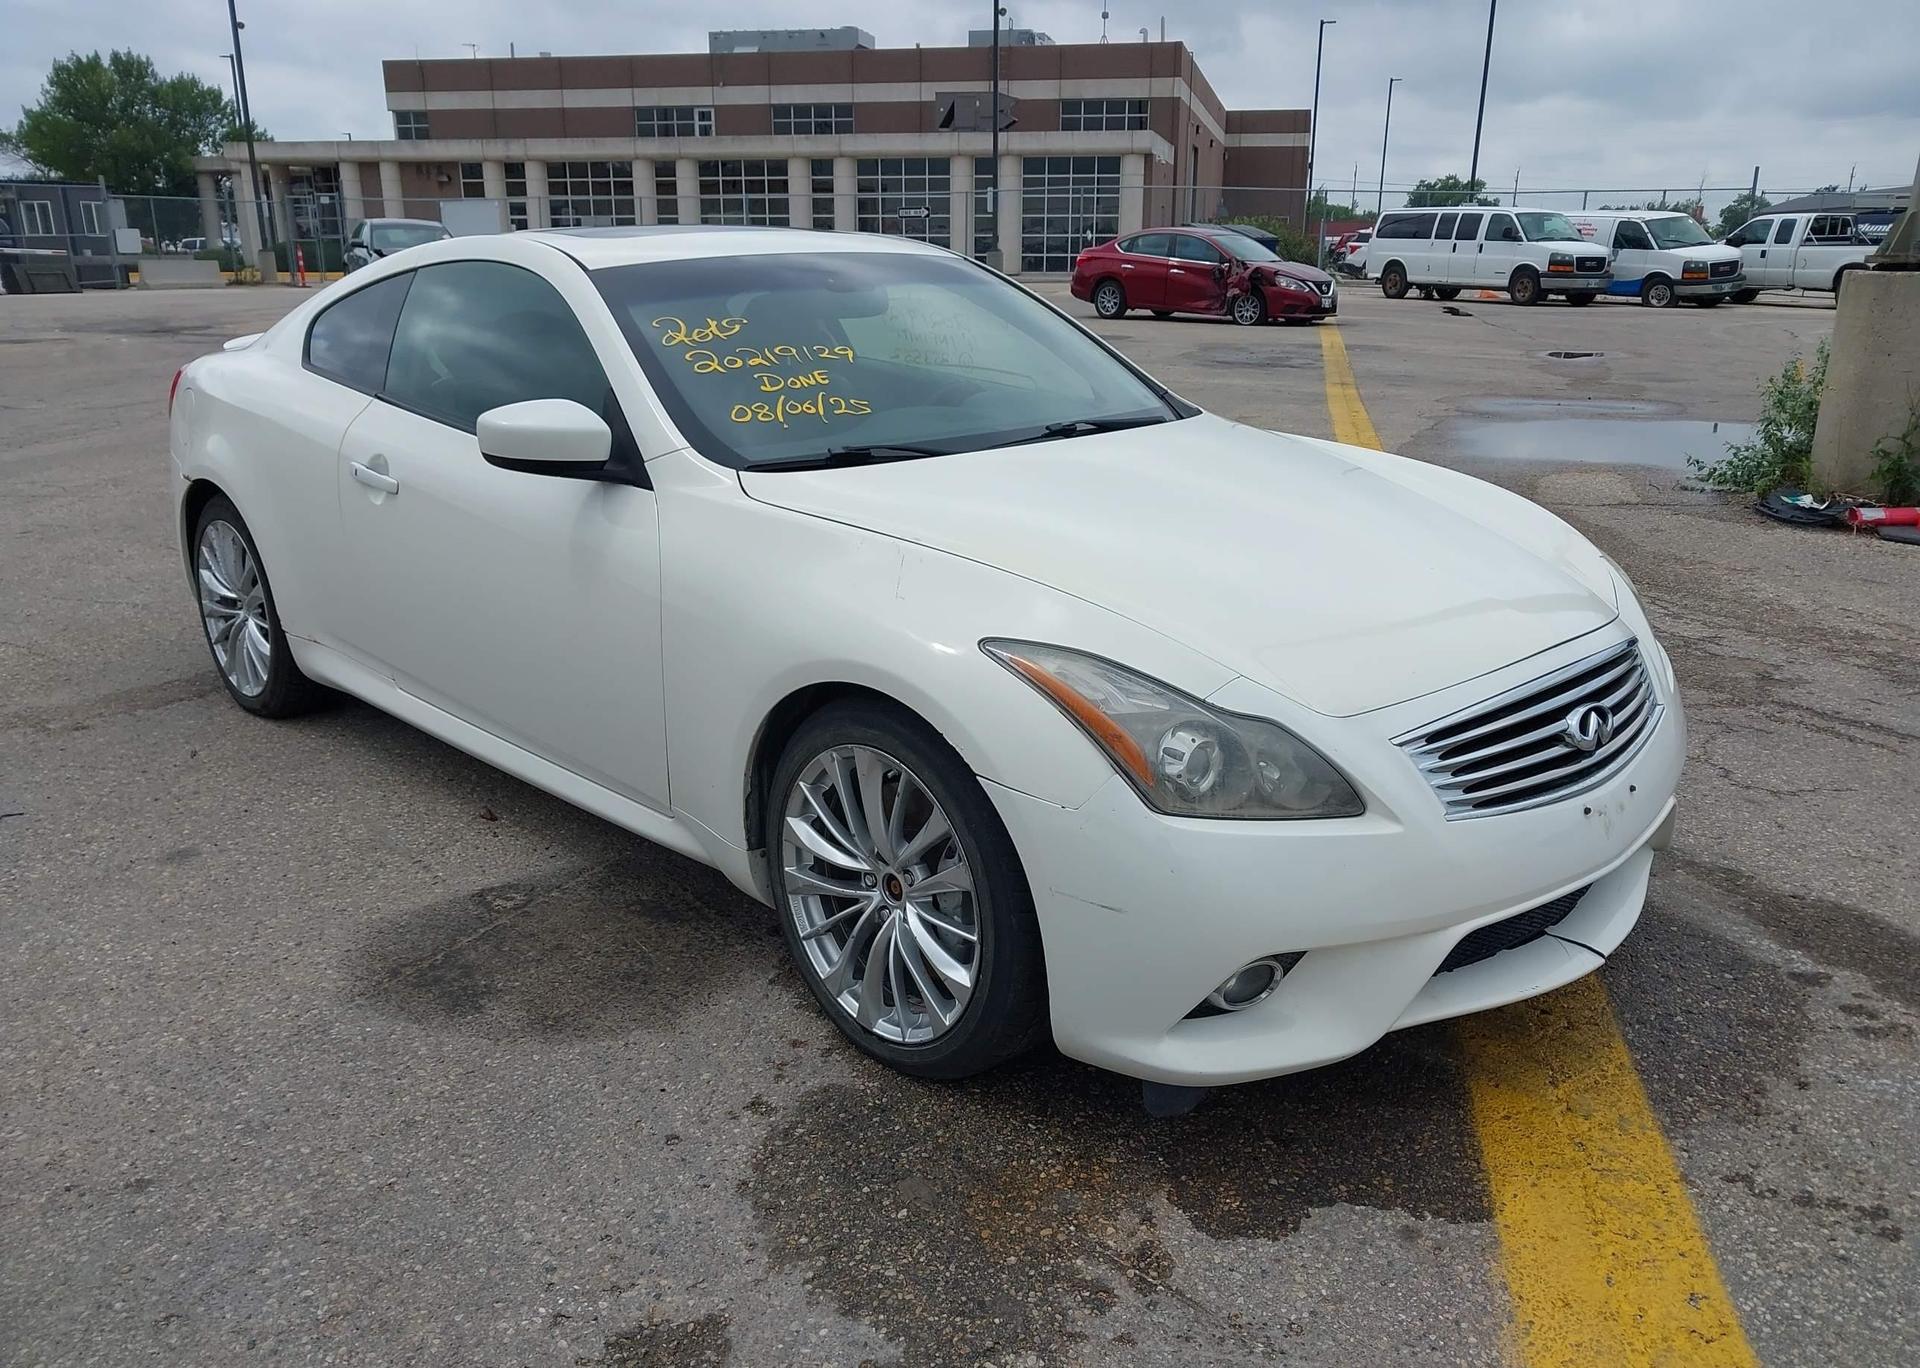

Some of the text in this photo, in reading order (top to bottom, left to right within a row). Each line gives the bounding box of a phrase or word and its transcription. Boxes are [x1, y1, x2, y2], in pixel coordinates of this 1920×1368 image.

[684, 345, 856, 374] 20219129
[753, 370, 831, 393] DONE
[730, 391, 873, 428] 08/06/25
